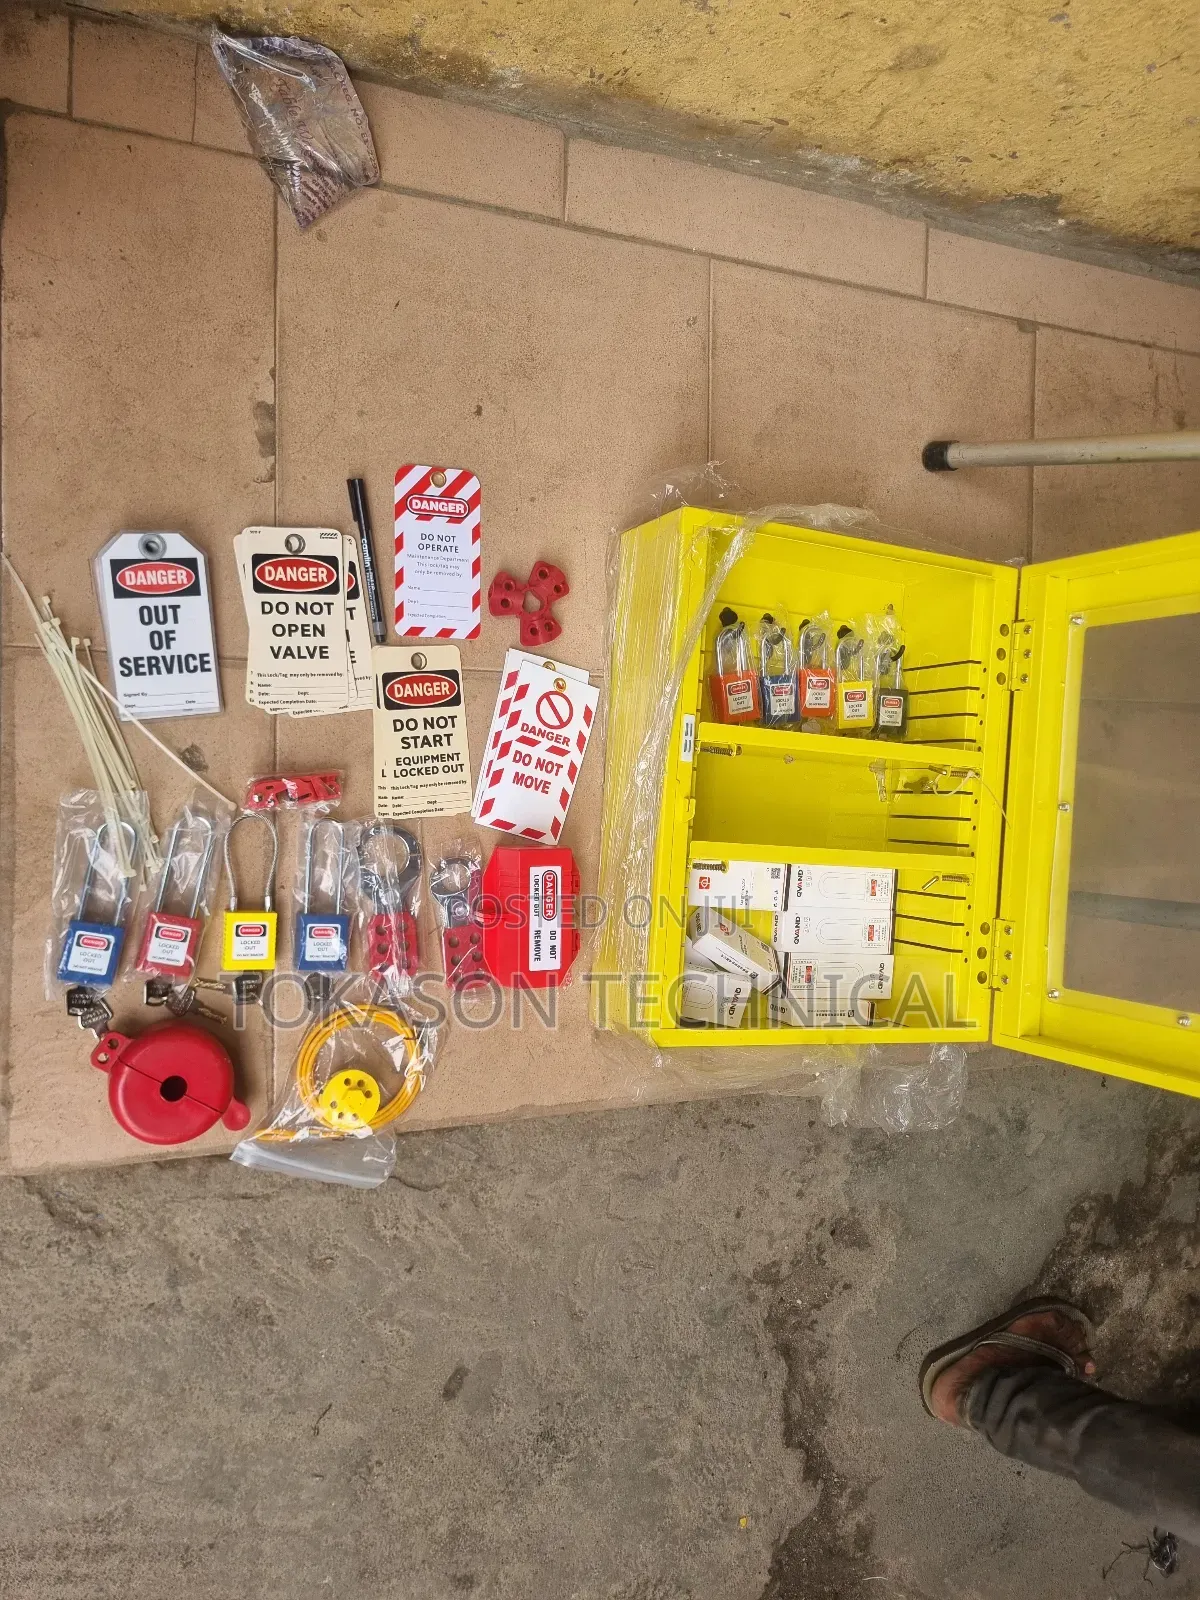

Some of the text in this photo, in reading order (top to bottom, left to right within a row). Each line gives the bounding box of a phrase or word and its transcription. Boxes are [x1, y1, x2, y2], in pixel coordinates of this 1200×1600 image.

[412, 499, 464, 514] DANGER
[420, 533, 456, 543] DO NOT
[362, 538, 372, 568] camlin
[418, 543, 459, 553] OPERATE
[125, 570, 188, 586] DANGER
[264, 566, 328, 582] DANGER
[139, 605, 181, 626] OUT
[261, 601, 289, 615] DO
[296, 602, 334, 615] NOT
[272, 624, 325, 637] OPEN
[149, 630, 176, 650] OF
[270, 646, 329, 659] VALVE
[119, 653, 212, 677] SERVICE
[394, 682, 450, 698] DANGER
[393, 715, 457, 732] DO NOT
[401, 733, 453, 749] START
[521, 722, 570, 747] DANGER
[396, 752, 460, 766] EQUIPMENT
[512, 750, 563, 776] DO NOT
[394, 766, 439, 778] LOCKED
[442, 764, 464, 774] OUT
[512, 772, 551, 794] MOVE
[545, 875, 554, 917] DANGER
[550, 930, 556, 940] DO
[729, 988, 741, 1015] QVAND
